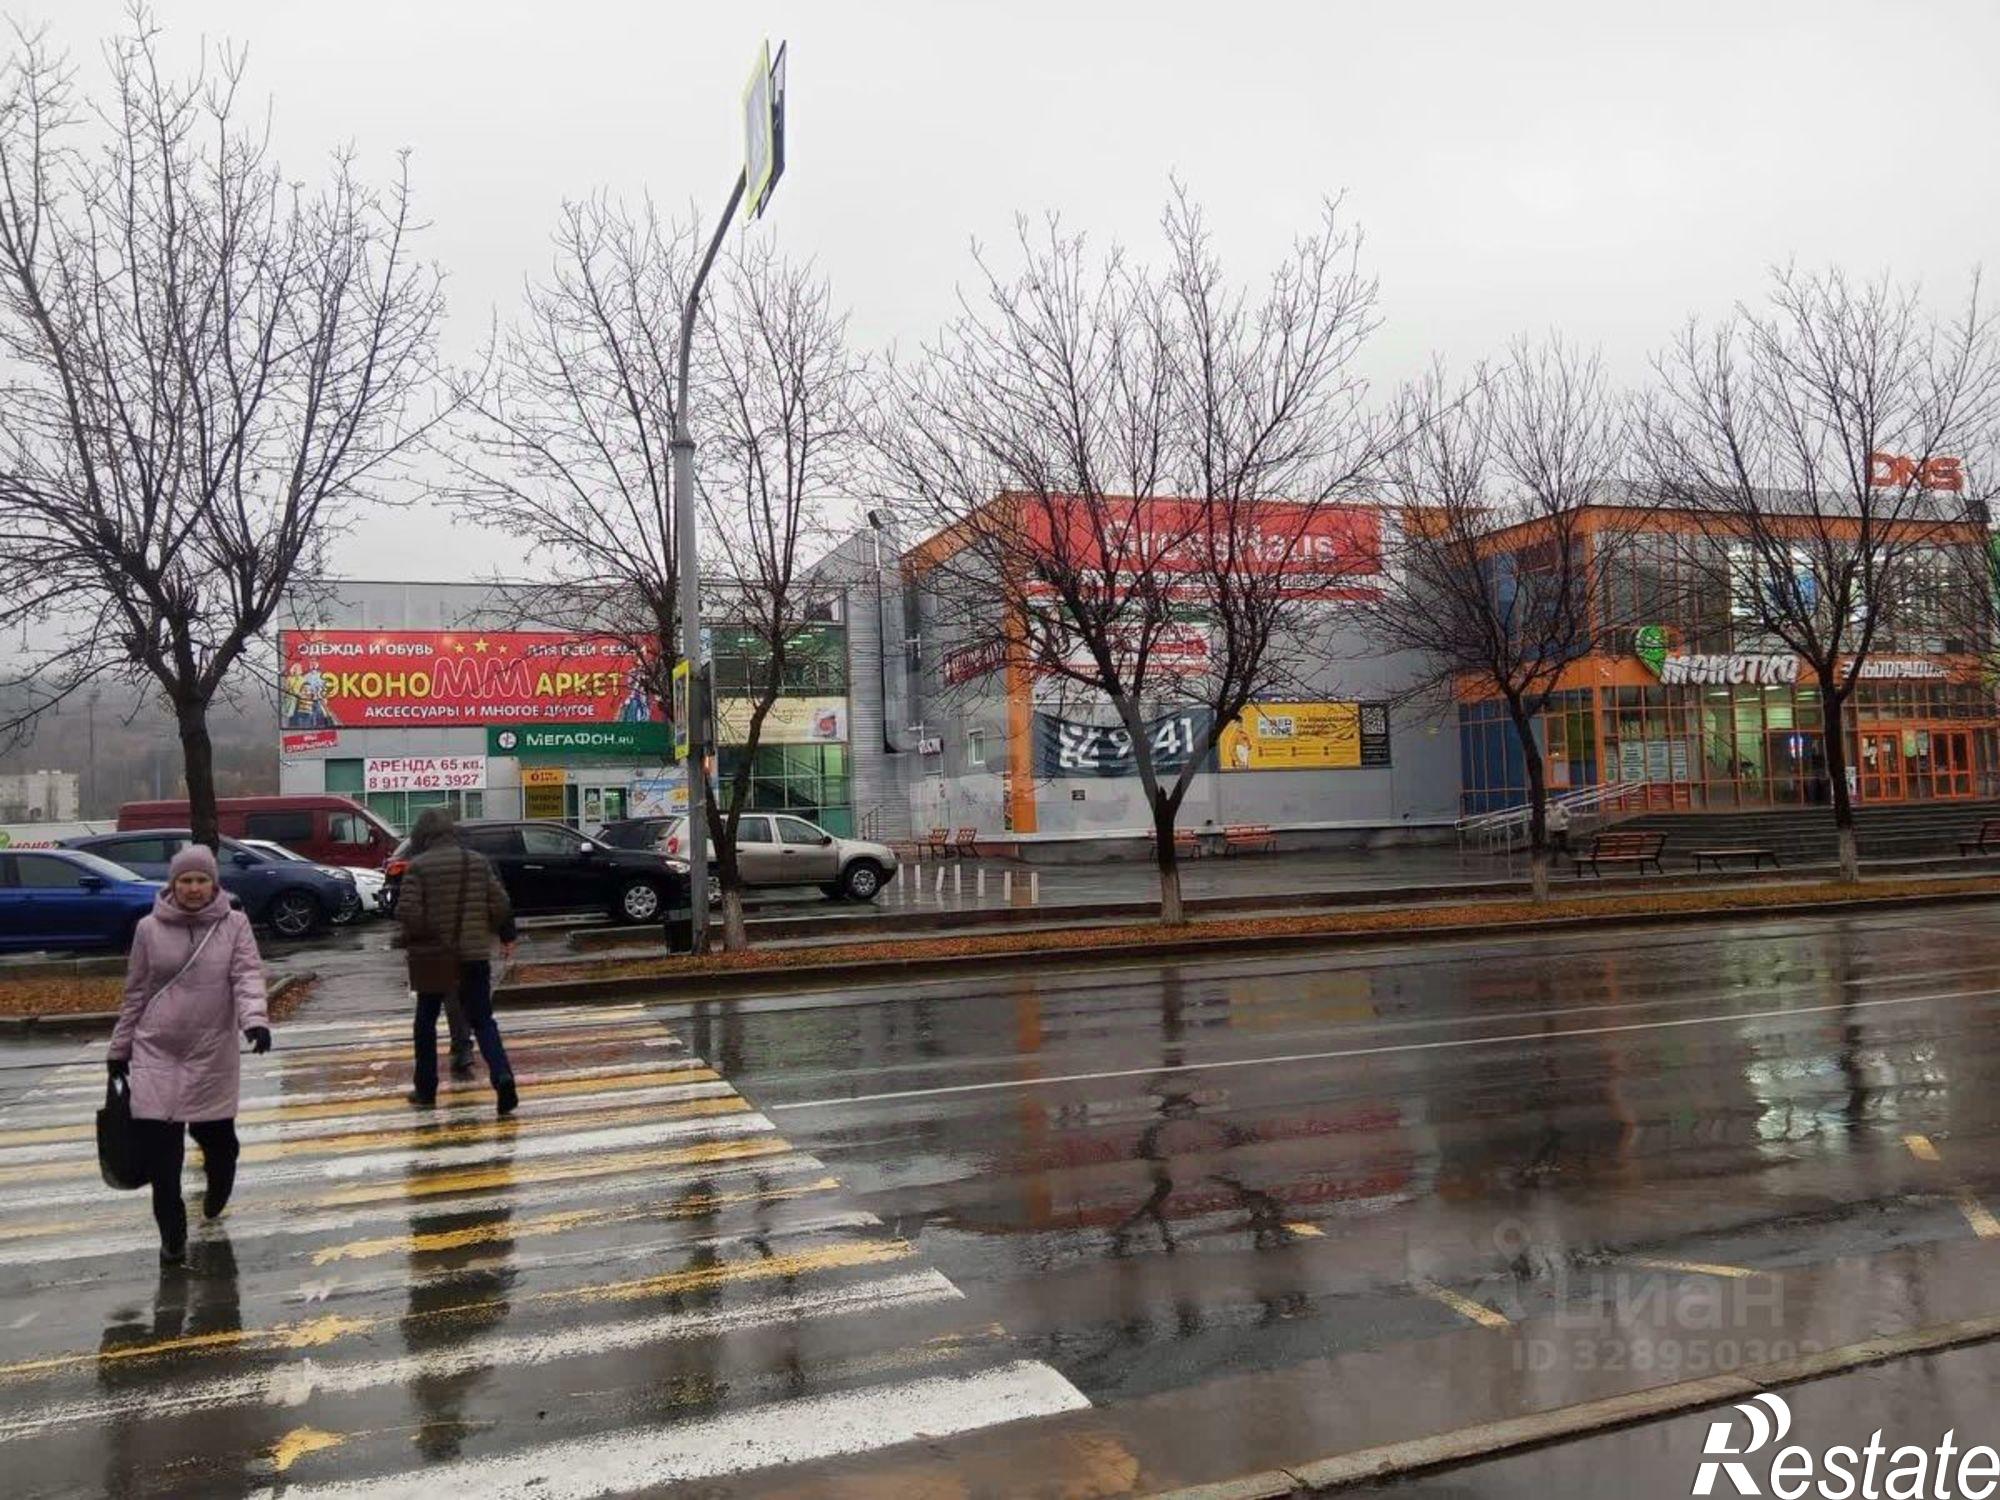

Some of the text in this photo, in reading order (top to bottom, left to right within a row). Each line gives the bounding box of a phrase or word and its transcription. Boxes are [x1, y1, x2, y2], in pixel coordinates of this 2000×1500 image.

[1869, 453, 1962, 491] DNS
[298, 643, 434, 656] ОДЕЖДА И ОБУВЬ
[365, 704, 595, 718] АКСЕССУАРЫ И МНОГОЕ ДРУГОЕ
[368, 759, 436, 772] АРЕНДА
[441, 758, 458, 771] 65
[369, 774, 480, 788] 8 917 462 3927
